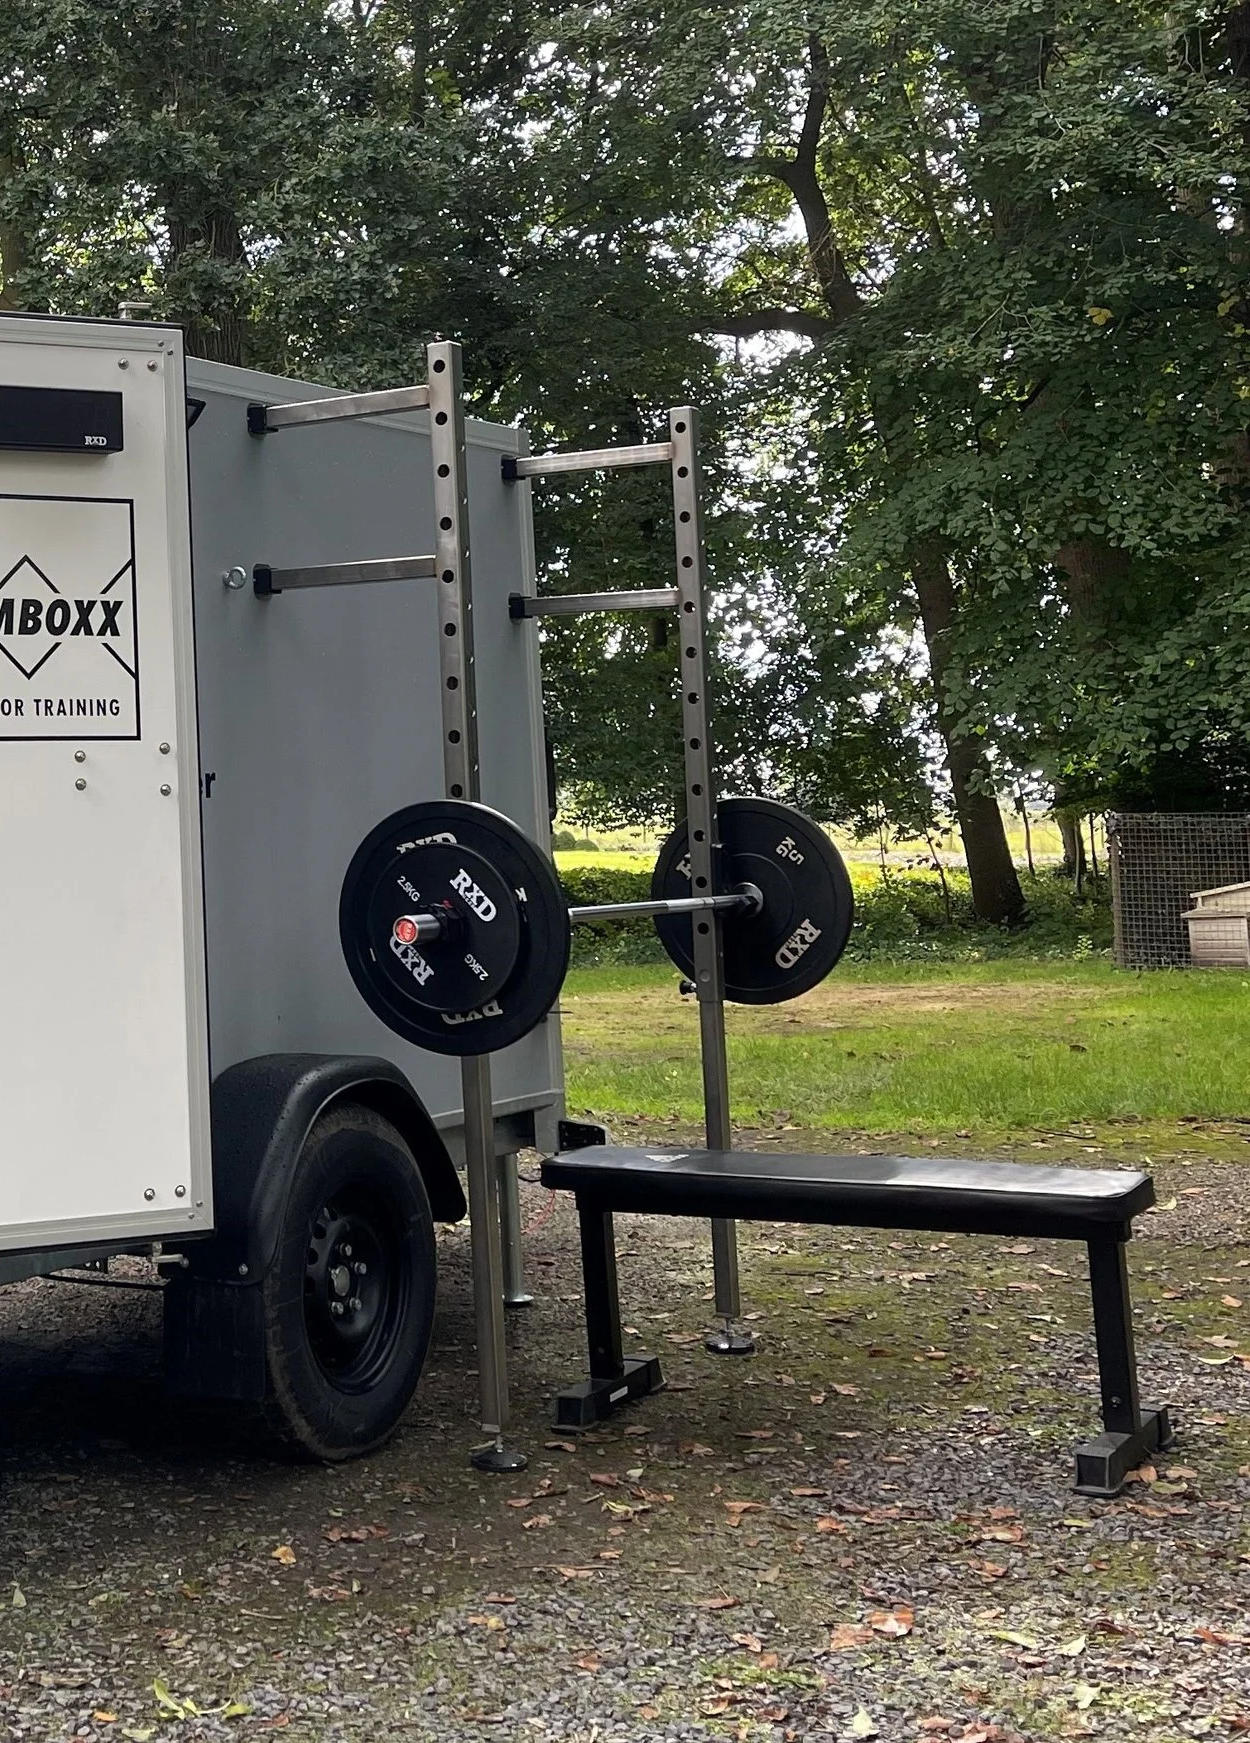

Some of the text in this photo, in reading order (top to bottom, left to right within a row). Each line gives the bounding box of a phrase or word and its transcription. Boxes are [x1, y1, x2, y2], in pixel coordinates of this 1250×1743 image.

[84, 435, 107, 447] RXD
[33, 698, 121, 717] TRAINING
[775, 836, 796, 858] KG
[788, 851, 805, 866] 5
[450, 868, 498, 922] RXD
[775, 918, 822, 969] RXD
[389, 936, 435, 986] RXD
